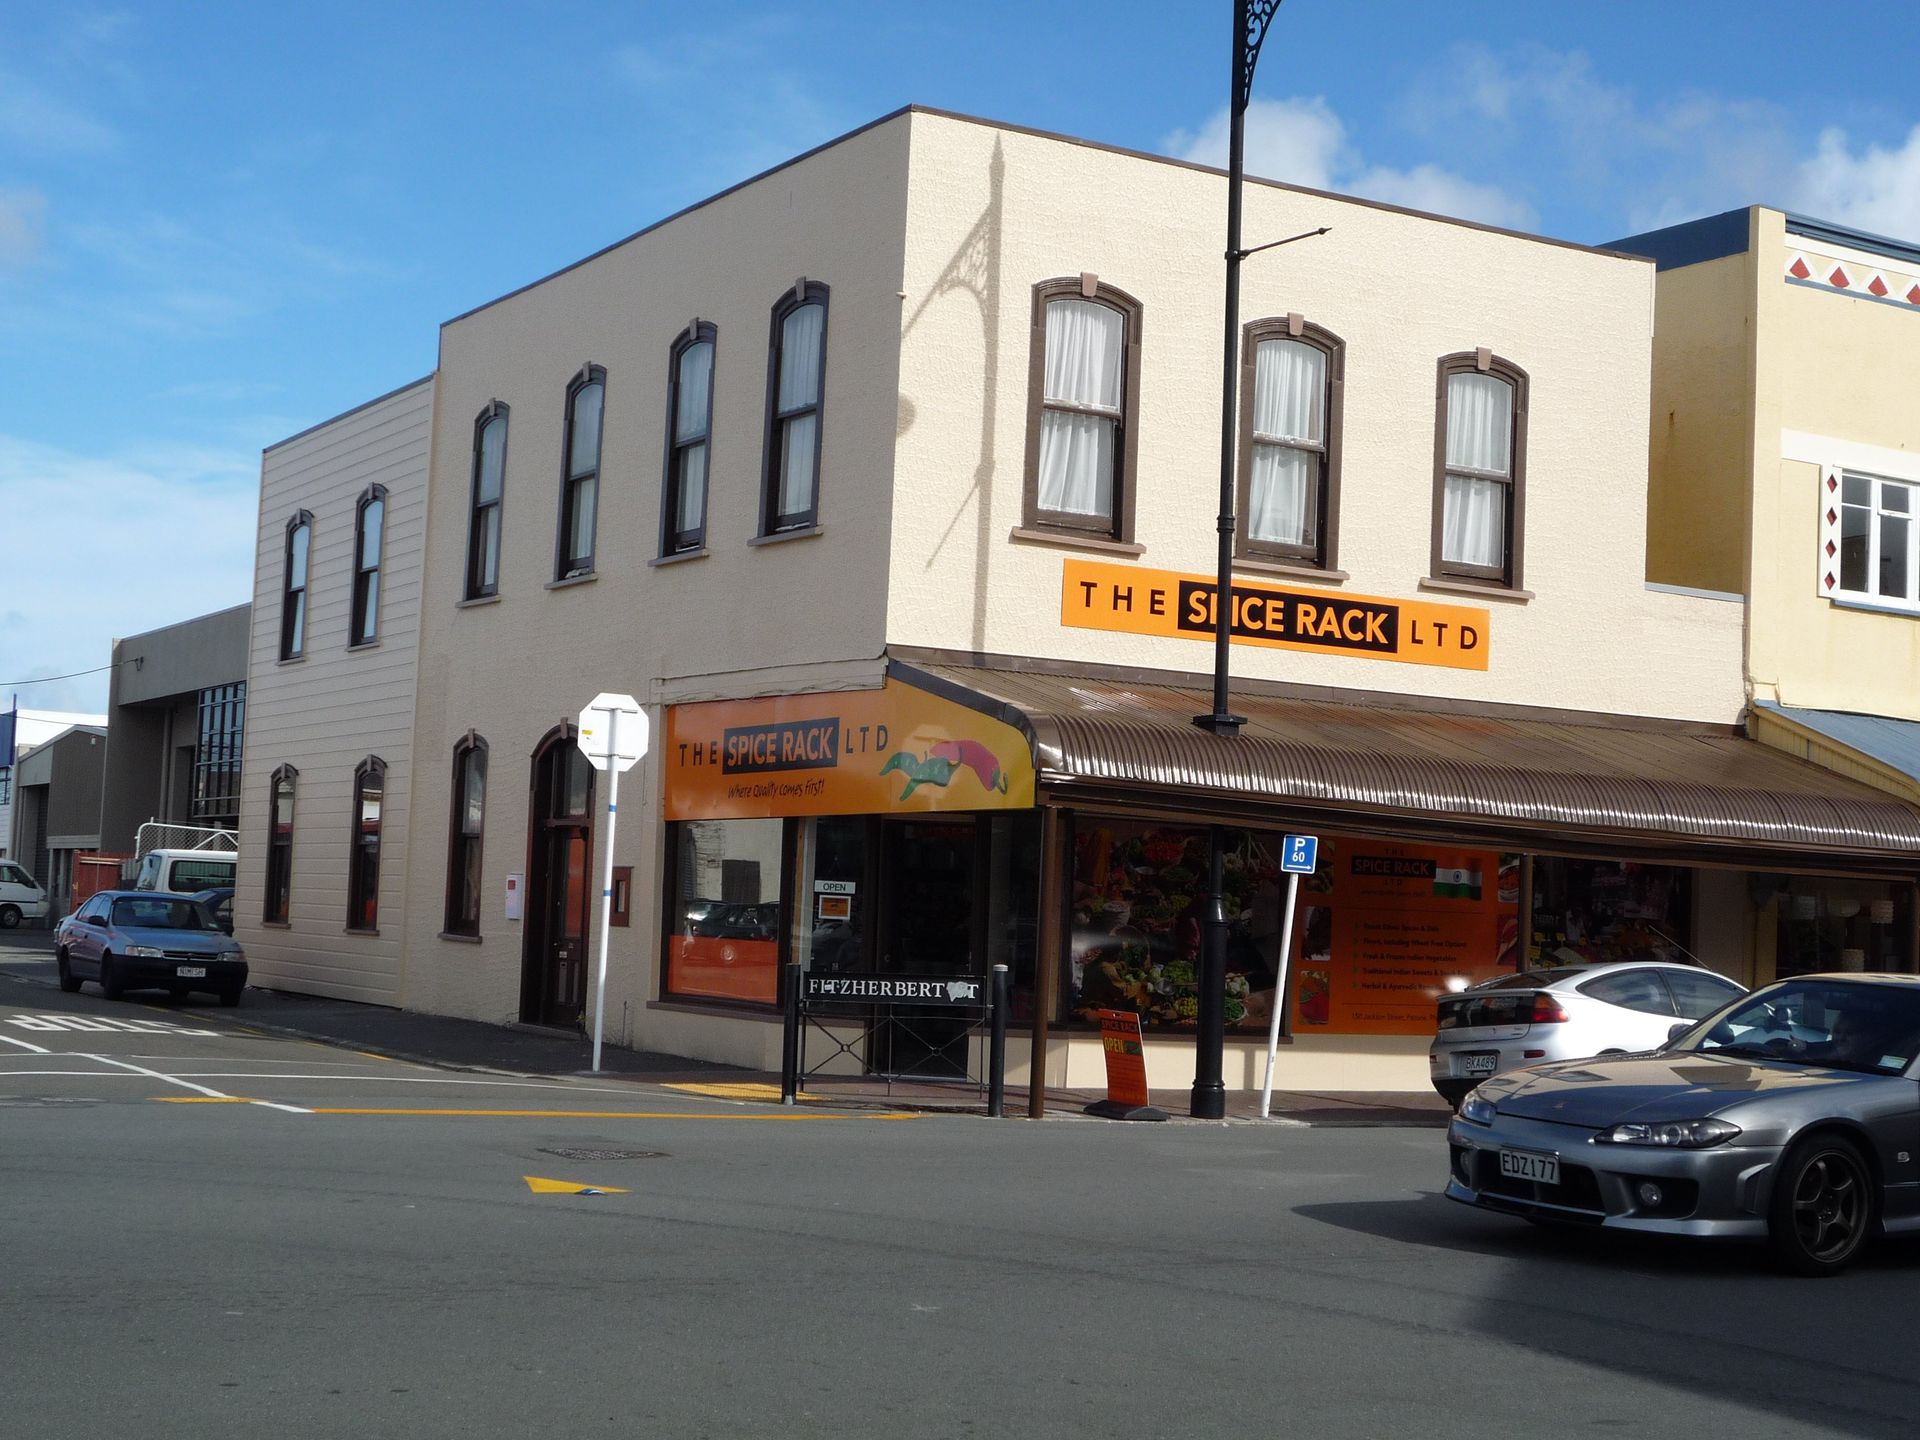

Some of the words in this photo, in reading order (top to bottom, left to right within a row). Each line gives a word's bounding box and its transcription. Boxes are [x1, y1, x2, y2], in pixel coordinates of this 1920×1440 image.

[1080, 581, 1165, 616] THE
[1297, 603, 1389, 644] RACK
[1412, 620, 1478, 650] LTD
[679, 741, 717, 767] THE
[727, 732, 776, 767] SPICE
[782, 726, 833, 763] RACK
[845, 724, 888, 755] LTD
[728, 784, 752, 799] Where
[753, 780, 778, 799] Quality
[1294, 838, 1306, 851] P
[1292, 852, 1305, 862] 60
[1355, 859, 1391, 873] SPICE
[1394, 861, 1429, 875] RACK
[823, 883, 846, 892] OPEN
[809, 978, 946, 998] FITZHERBERT
[1104, 1037, 1124, 1053] OPEN
[1502, 1152, 1555, 1180] EDZ177
